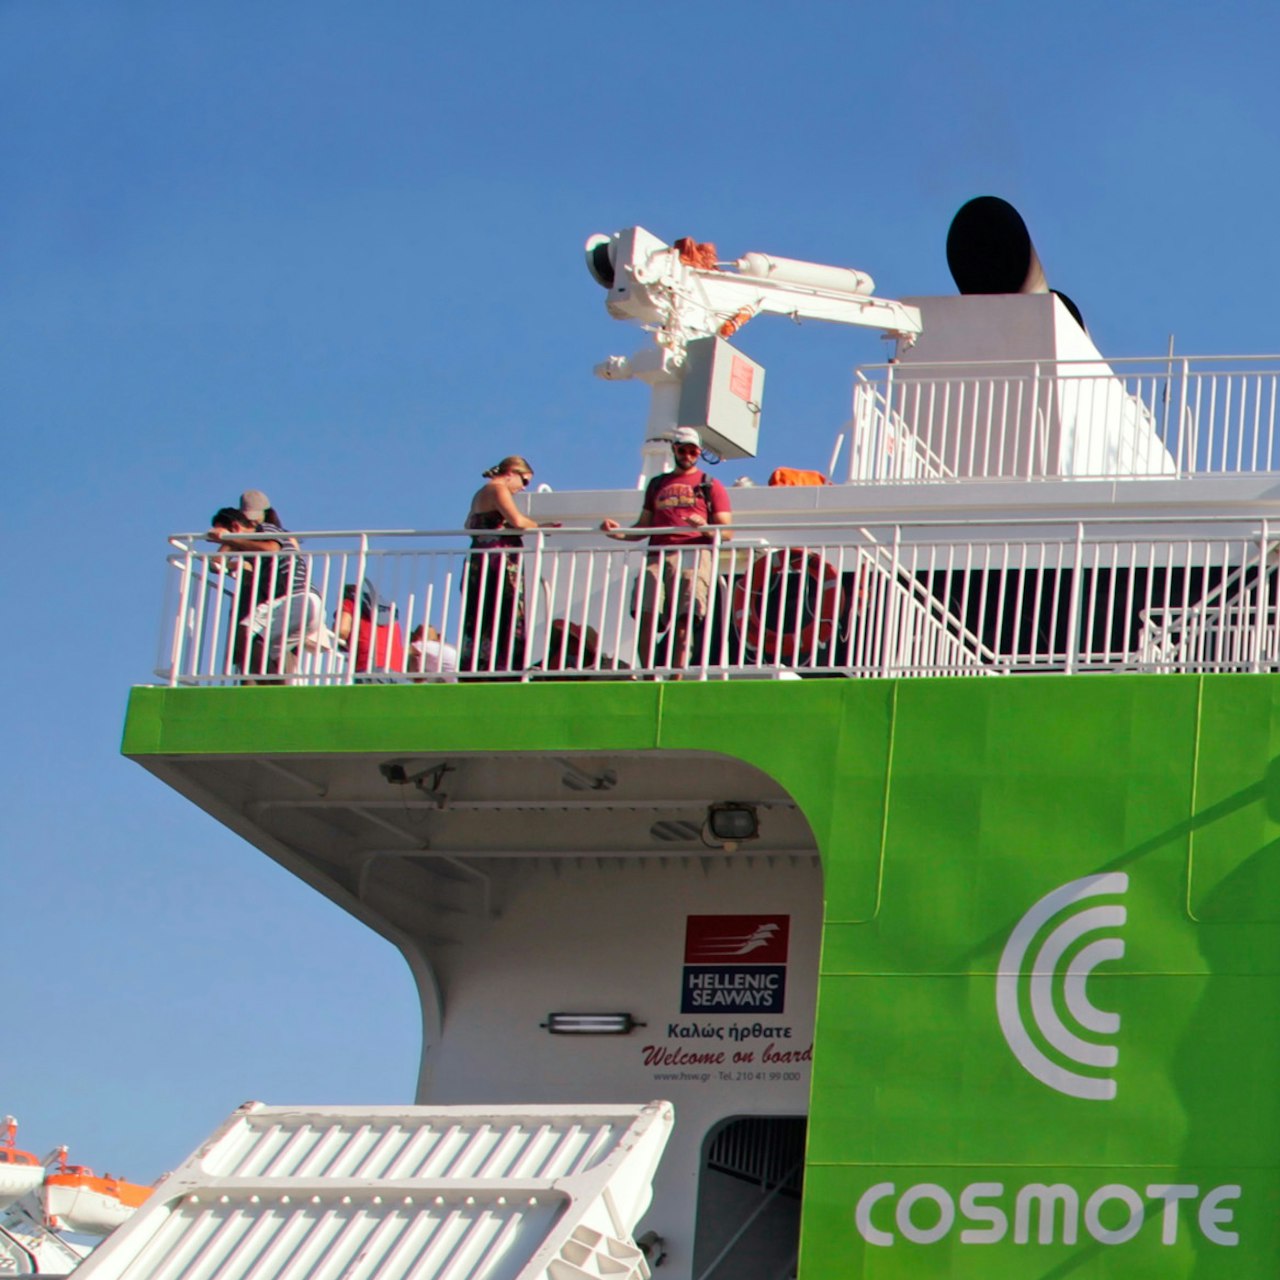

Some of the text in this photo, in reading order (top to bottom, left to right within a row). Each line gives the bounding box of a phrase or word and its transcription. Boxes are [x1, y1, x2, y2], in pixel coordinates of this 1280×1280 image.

[688, 973, 779, 989] HELLENIC
[691, 990, 774, 1006] SEAWAYS
[667, 1022, 792, 1041] Καλώς ήρθατε
[641, 1043, 814, 1066] Welcome on board
[653, 1071, 711, 1083] www.hsw.gr
[736, 1072, 753, 1081] 210
[755, 1072, 766, 1081] 41
[768, 1072, 781, 1081] 99
[783, 1072, 801, 1081] 000
[855, 1181, 1242, 1247] COSMOTE
